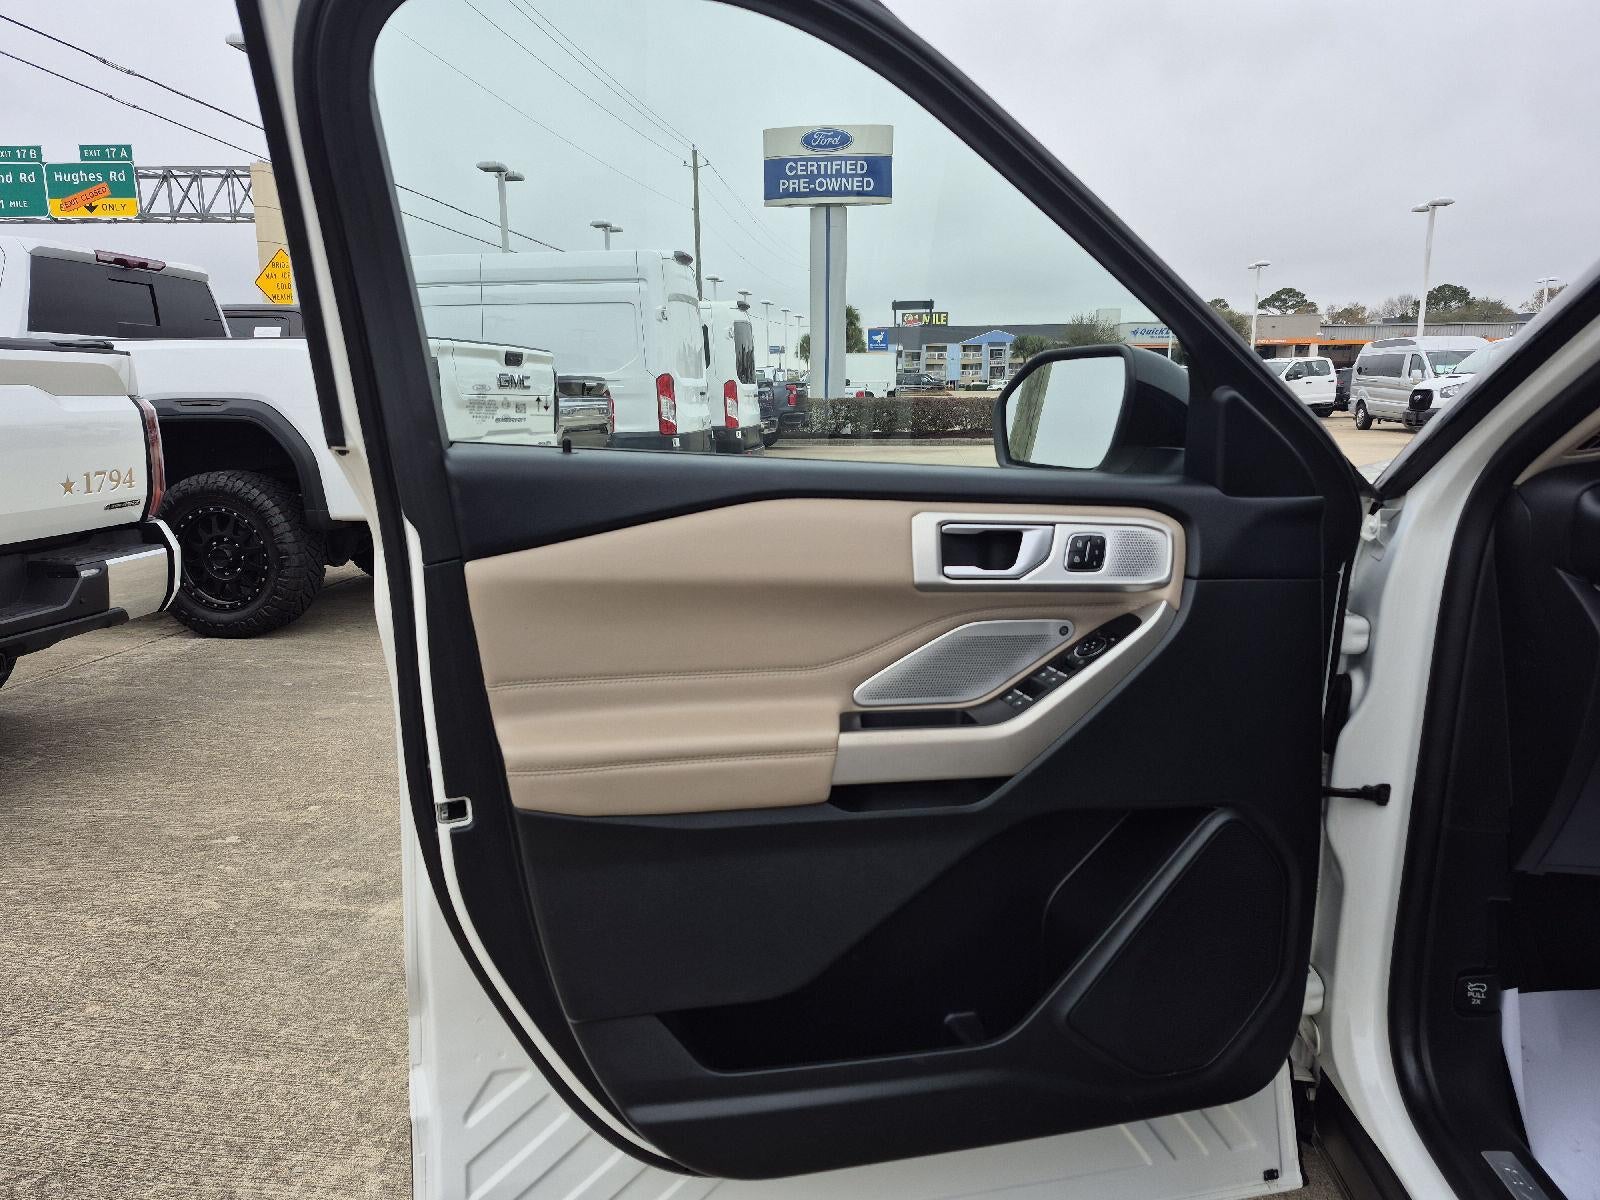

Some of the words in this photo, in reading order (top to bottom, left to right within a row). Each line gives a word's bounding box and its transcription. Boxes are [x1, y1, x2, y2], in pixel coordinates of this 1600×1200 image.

[811, 131, 841, 146] Ford
[0, 150, 11, 158] XIT
[84, 149, 100, 157] EXIT
[105, 147, 117, 158] 17
[120, 147, 128, 158] A
[785, 160, 868, 176] CERTIFIED
[20, 171, 36, 183] Rd
[54, 170, 103, 185] Hughes
[109, 170, 126, 182] Rd
[779, 177, 875, 193] PRE-OWNED
[80, 186, 107, 202] CLOSED
[10, 200, 28, 208] MILE
[101, 203, 127, 212] ONLY
[497, 373, 531, 390] GMC
[83, 466, 136, 495] 1794
[1467, 991, 1487, 999] PULL
